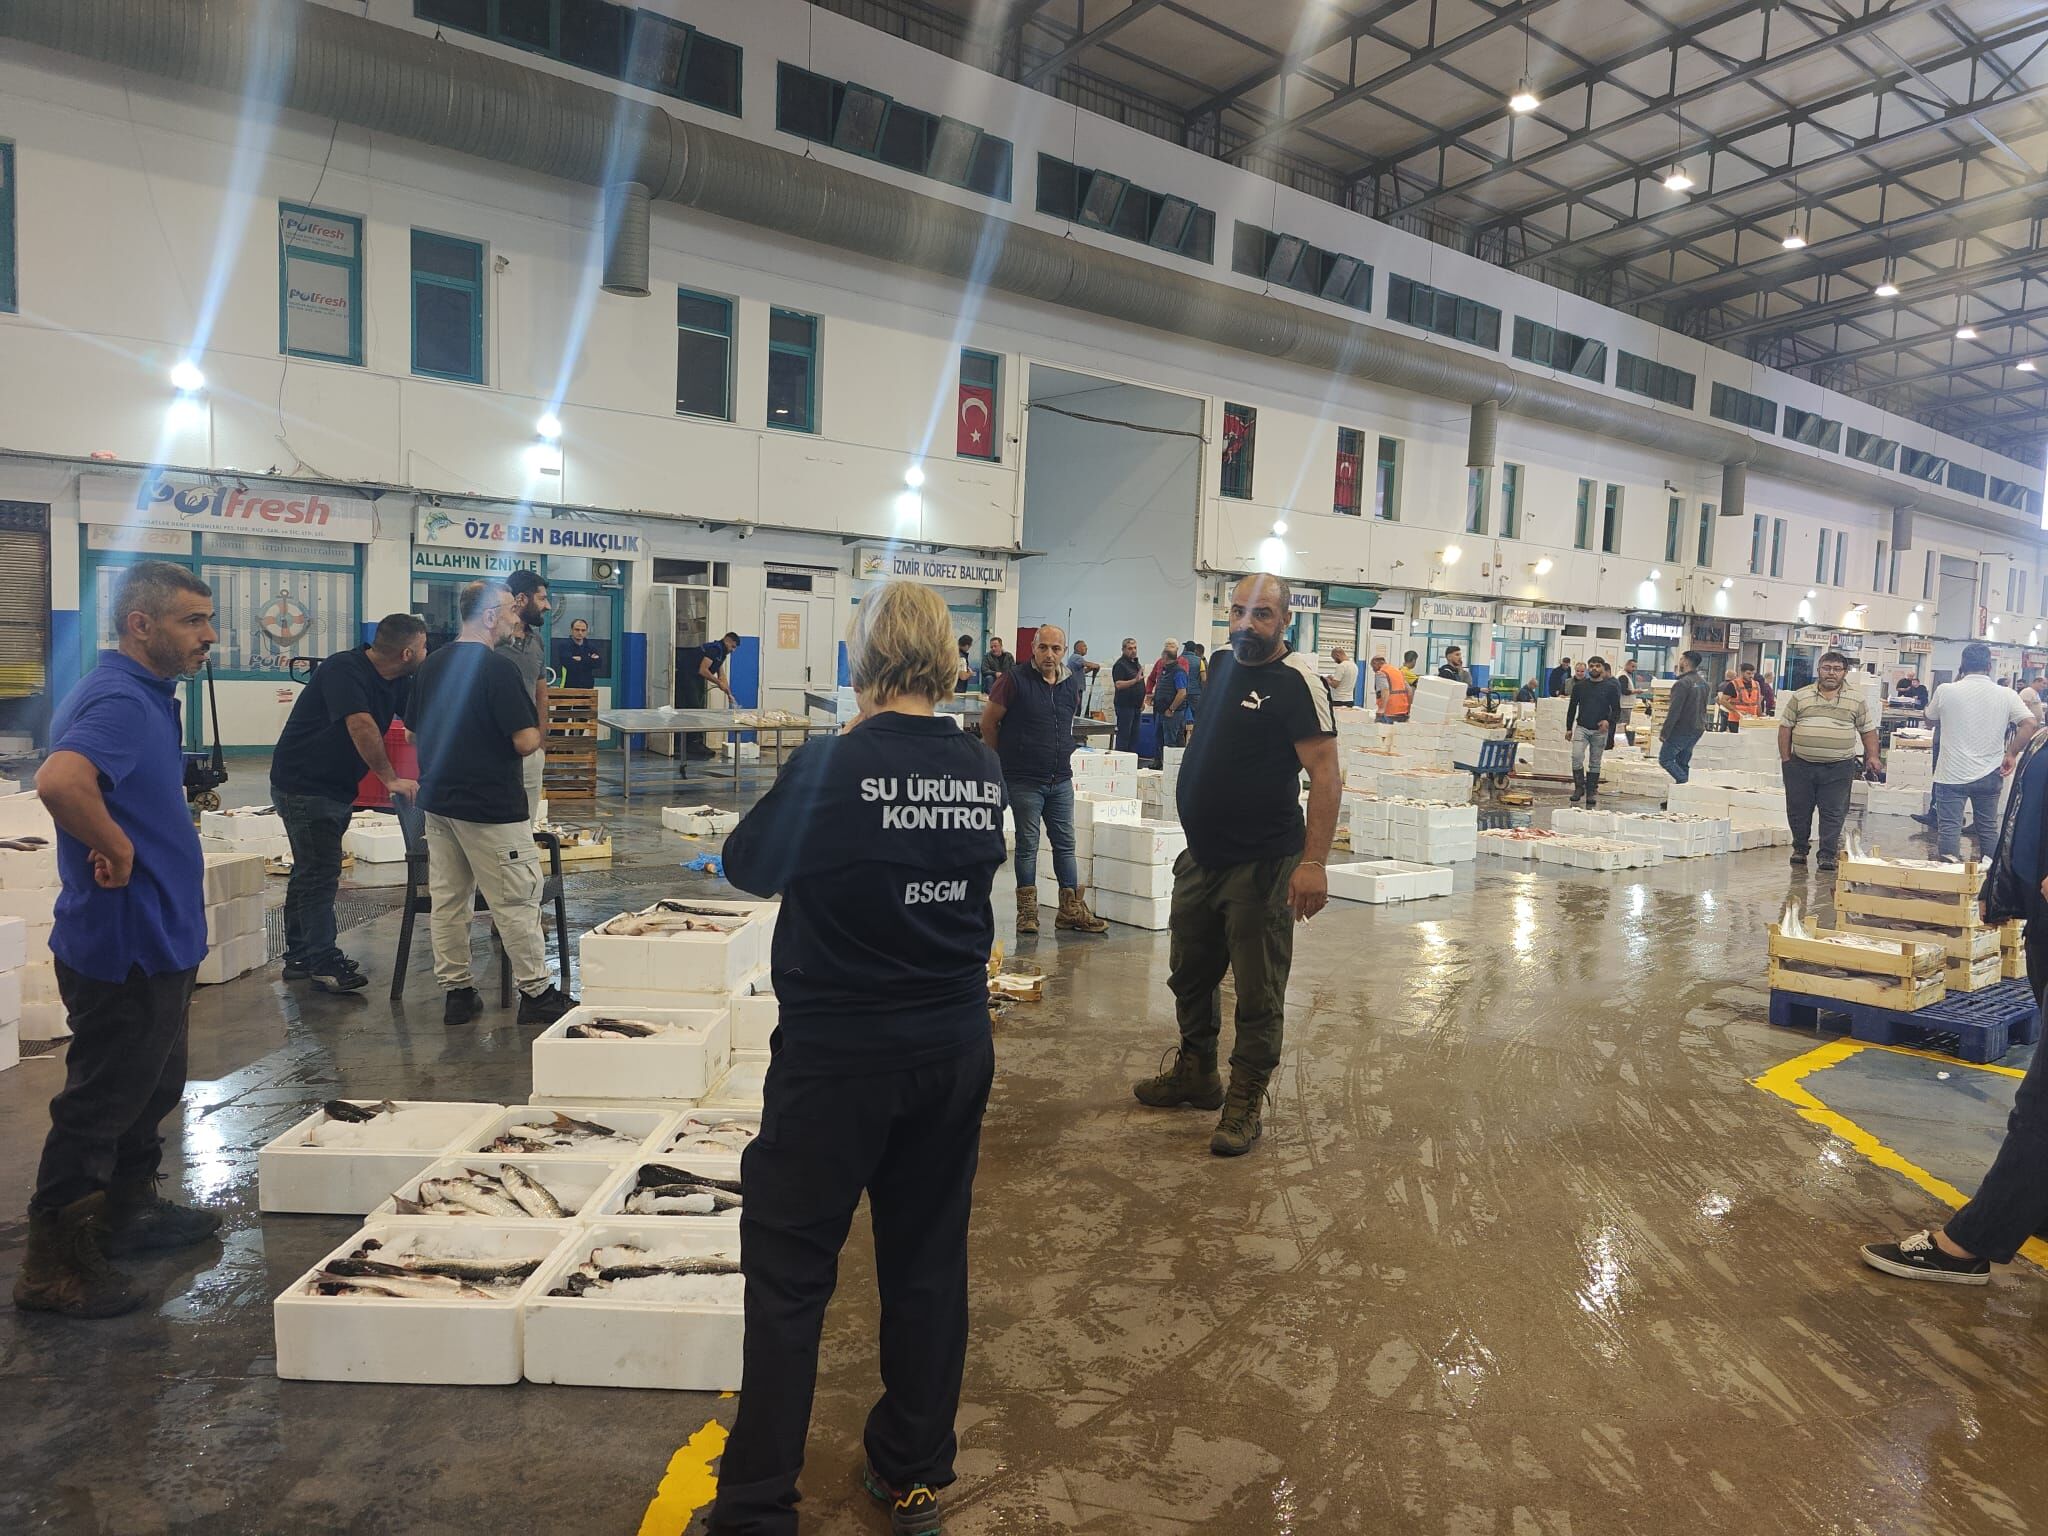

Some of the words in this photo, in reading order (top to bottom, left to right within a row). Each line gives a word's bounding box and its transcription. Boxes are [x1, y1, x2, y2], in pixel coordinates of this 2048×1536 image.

[550, 529, 639, 552] BALIKÇILIK
[485, 554, 537, 573] İZNİYLE
[893, 556, 920, 576] İZMİR
[923, 559, 957, 579] KÖRFEZ
[960, 565, 1003, 584] BALIKÇILIK
[861, 777, 897, 802] SU
[882, 805, 996, 831] KONTROL
[904, 879, 968, 905] BSGM
